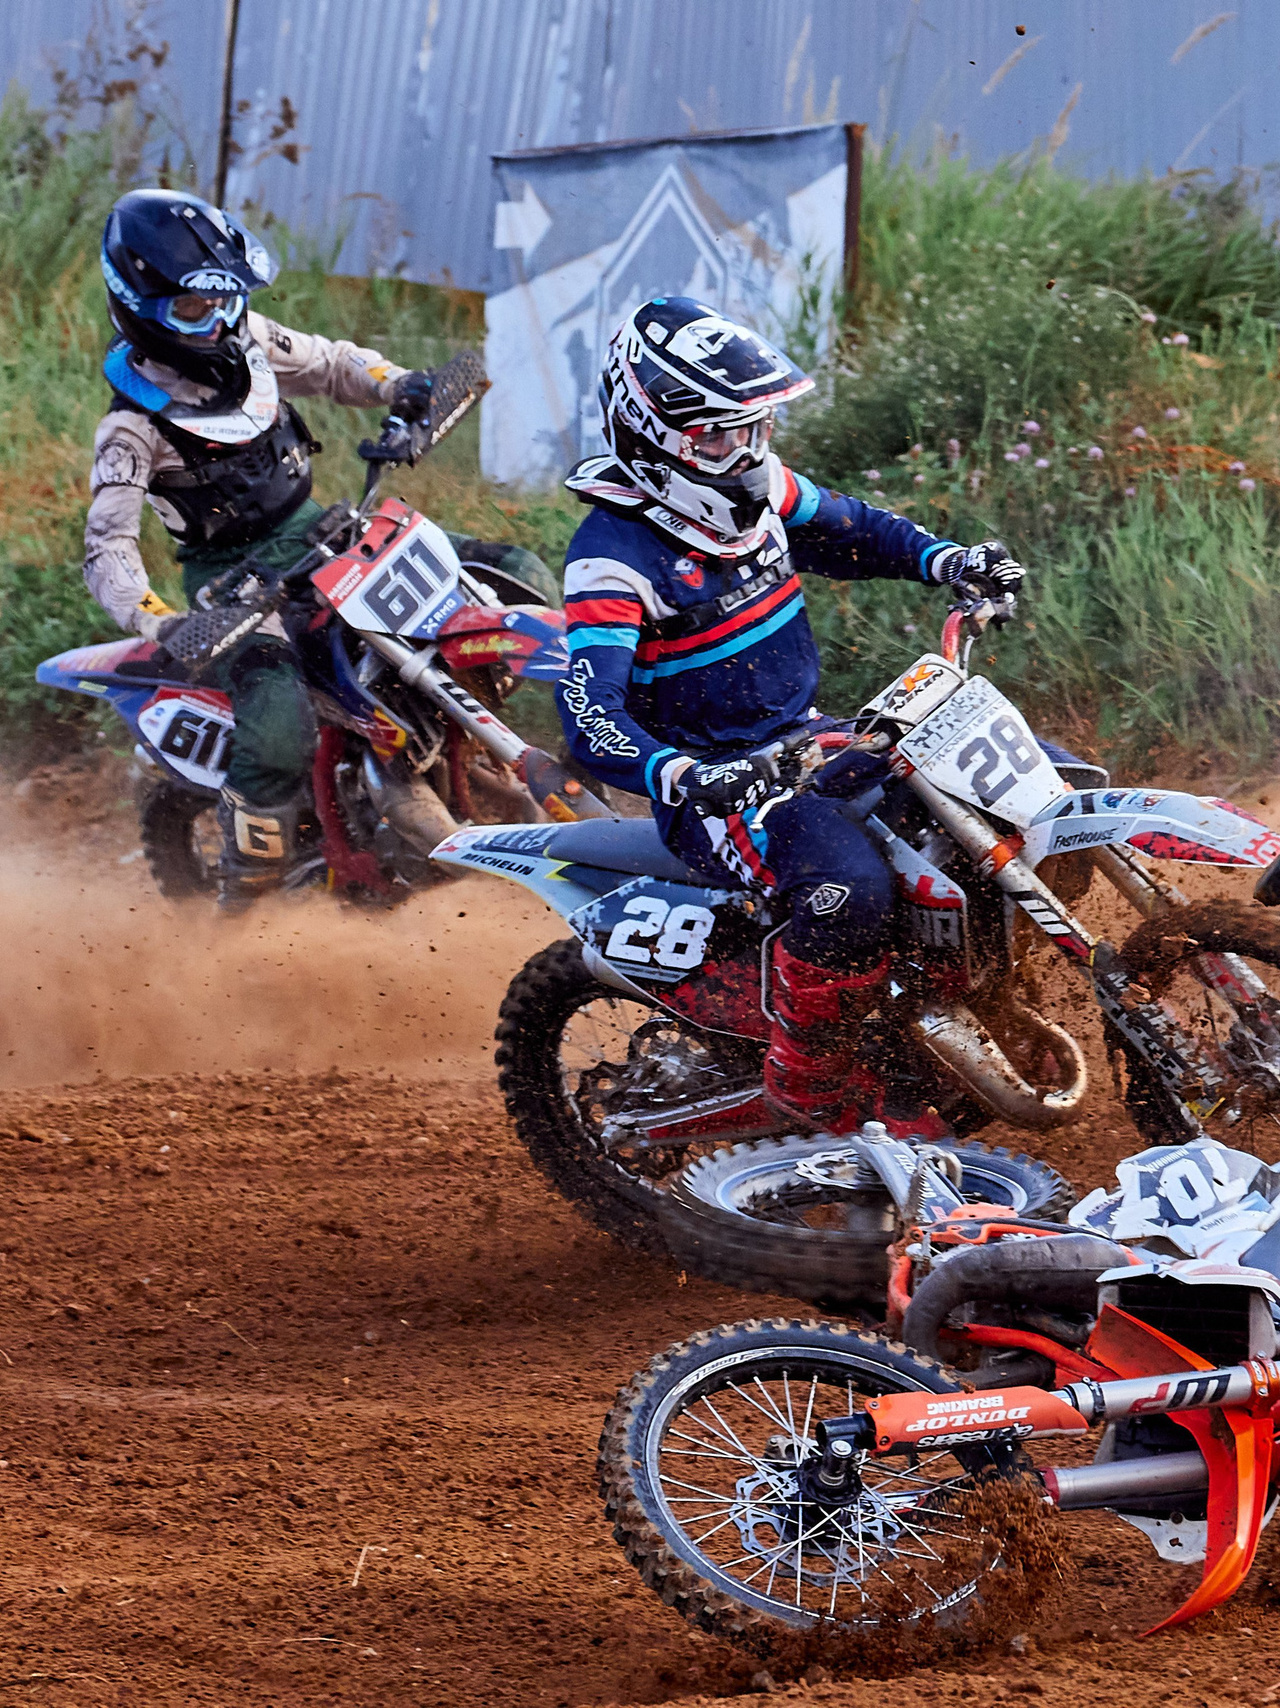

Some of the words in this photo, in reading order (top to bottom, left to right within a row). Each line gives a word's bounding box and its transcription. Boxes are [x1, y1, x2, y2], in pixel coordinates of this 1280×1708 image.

[187, 272, 238, 291] Airoh
[362, 536, 453, 634] 611
[160, 708, 235, 773] 611
[956, 714, 1042, 809] 28
[1053, 827, 1119, 850] FASTHOUSE
[460, 853, 535, 876] MICHELIN
[605, 895, 716, 970] 28
[926, 1395, 1004, 1415] BRAKING
[905, 1406, 1032, 1432] DUNLOP
